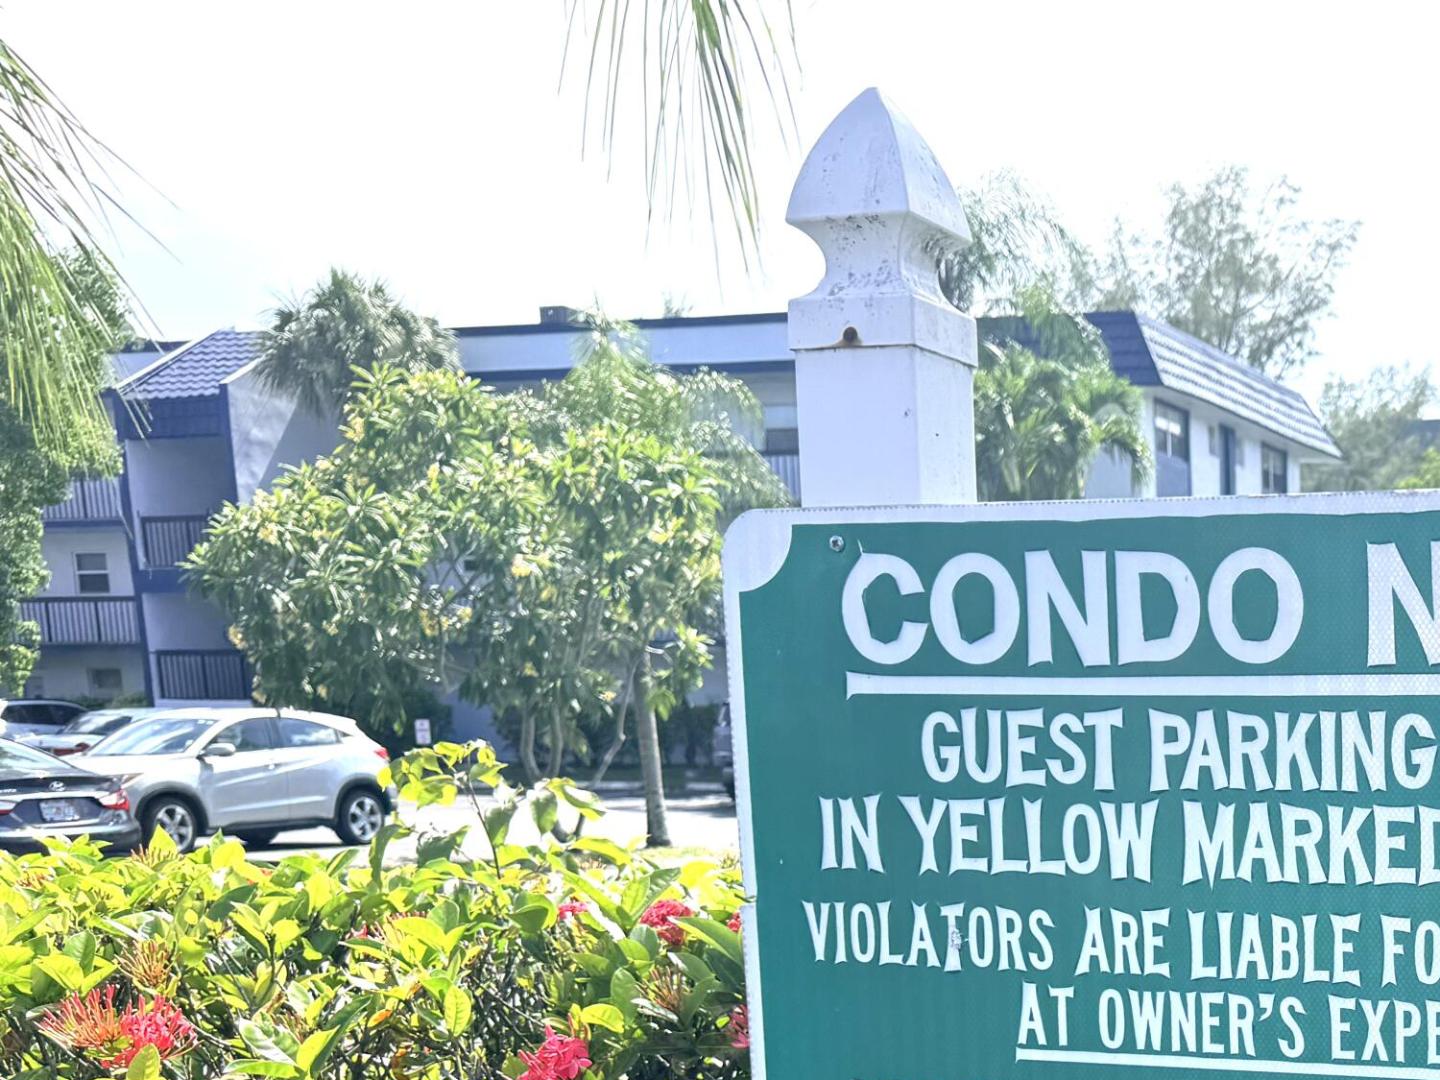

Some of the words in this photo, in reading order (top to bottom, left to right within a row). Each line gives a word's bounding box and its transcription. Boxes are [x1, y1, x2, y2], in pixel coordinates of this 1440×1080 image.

[842, 547, 1304, 667] CONDO
[922, 708, 1123, 790] GUEST
[1149, 709, 1437, 792] PARKING
[820, 794, 884, 873] IN
[903, 797, 1159, 883] YELLOW
[803, 901, 1055, 971] VIOLATORS
[1075, 906, 1170, 978] ARE
[1188, 909, 1361, 987] LIABLE
[1018, 982, 1074, 1046] AT
[1099, 989, 1306, 1058] OWNER'S
